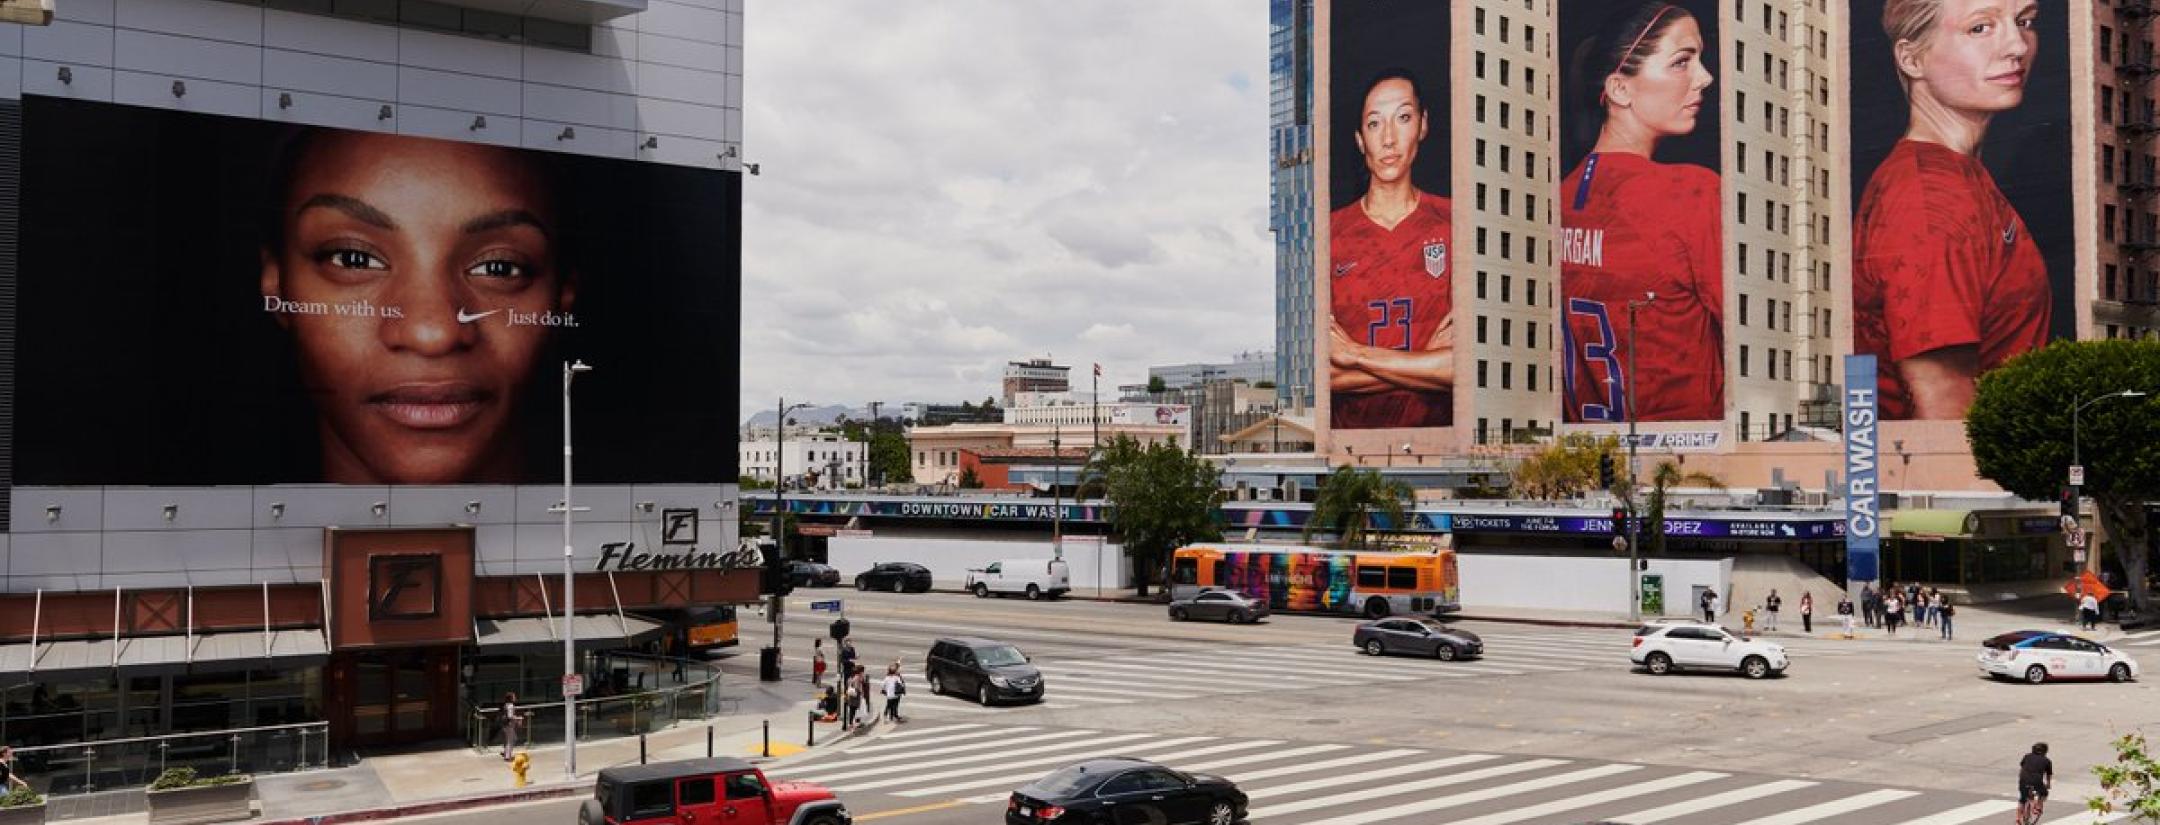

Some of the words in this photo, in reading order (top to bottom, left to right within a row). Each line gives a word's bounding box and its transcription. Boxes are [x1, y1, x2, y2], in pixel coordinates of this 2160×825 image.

[1561, 228, 1604, 267] RGAN
[263, 295, 329, 315] Dream
[334, 299, 375, 317] with
[381, 305, 404, 319] us.
[507, 308, 539, 327] Just
[540, 310, 560, 326] do
[564, 310, 579, 327] it.
[1368, 297, 1414, 352] 23
[1665, 432, 1715, 447] PRIME
[1849, 388, 1875, 474] WASH
[901, 502, 983, 517] DOWNTOWN
[990, 504, 1018, 518] CAR
[1025, 504, 1070, 519] WASH
[1850, 478, 1876, 538] CAR
[666, 513, 694, 541] F
[1474, 518, 1511, 529] TICKETS
[596, 541, 762, 571] Fleming's
